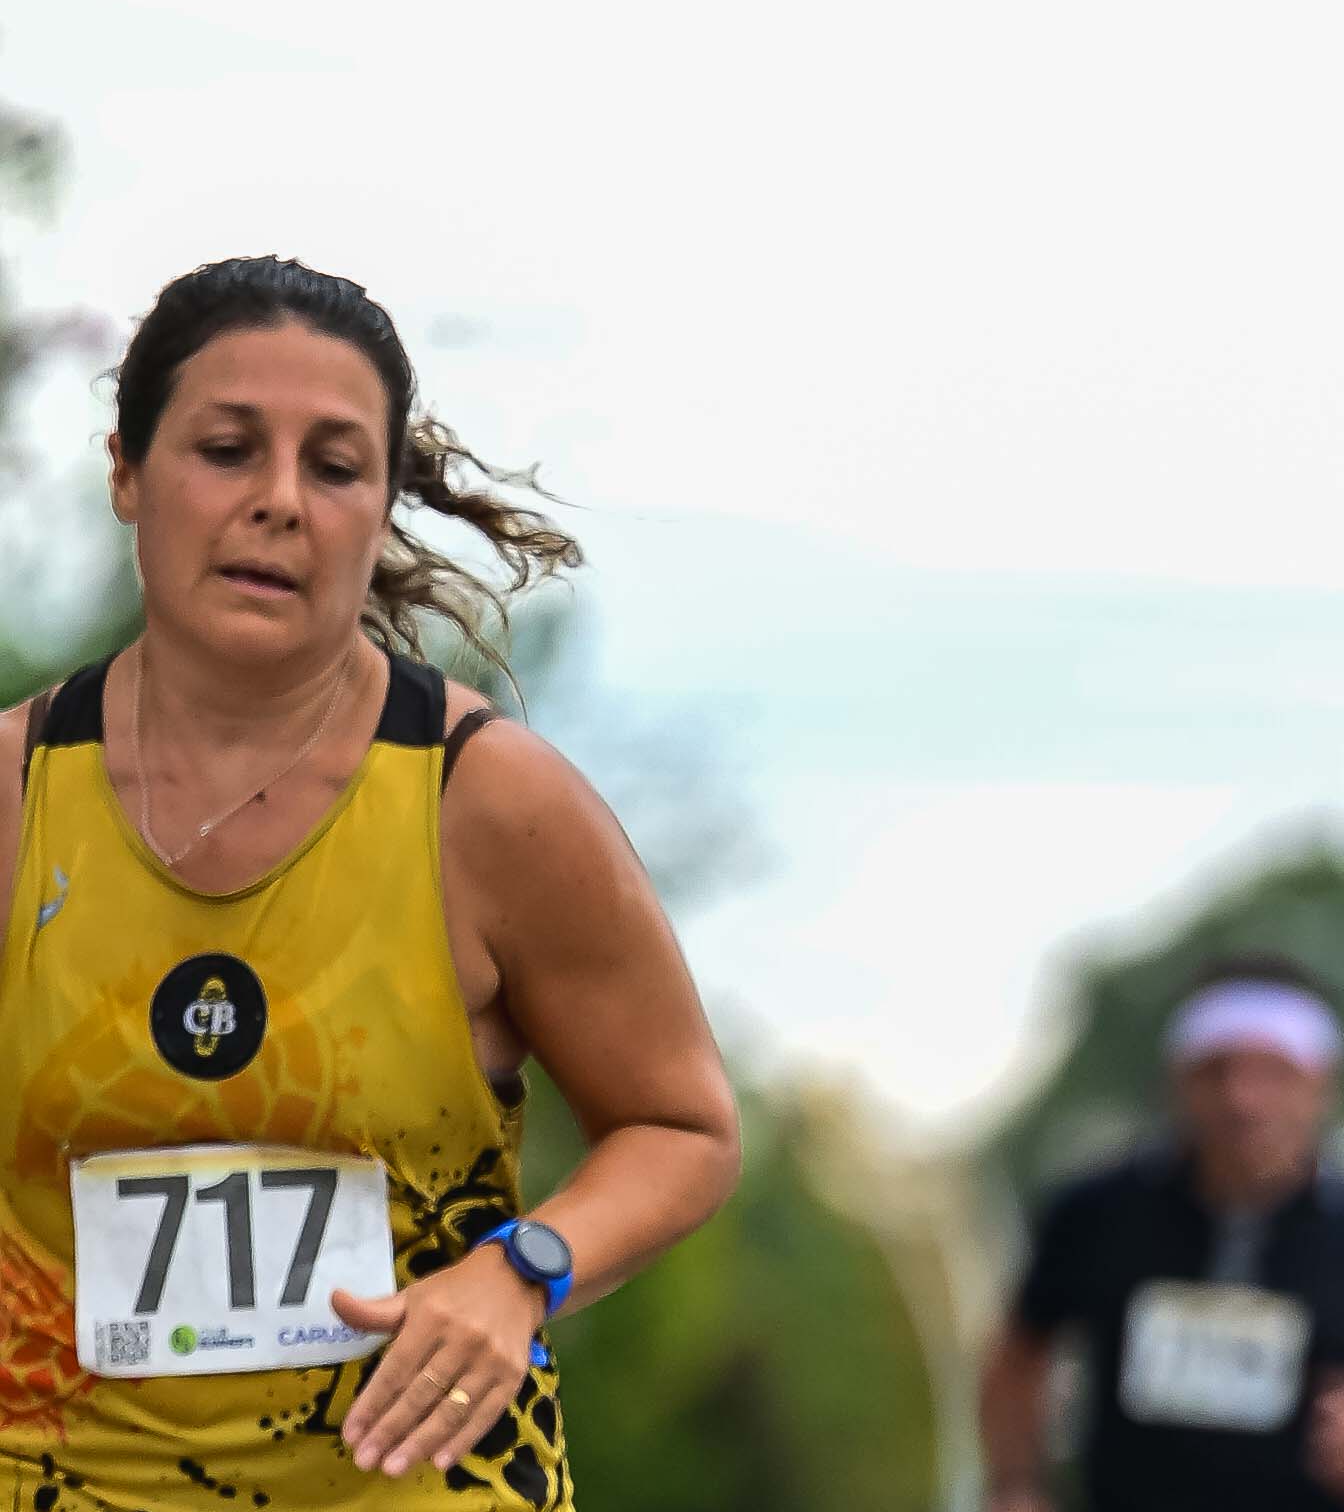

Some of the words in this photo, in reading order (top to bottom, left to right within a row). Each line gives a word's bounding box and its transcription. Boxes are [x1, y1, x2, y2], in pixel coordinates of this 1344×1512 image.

[182, 999, 237, 1036] CB
[118, 1168, 338, 1316] 717
[278, 1326, 366, 1347] CARUS
